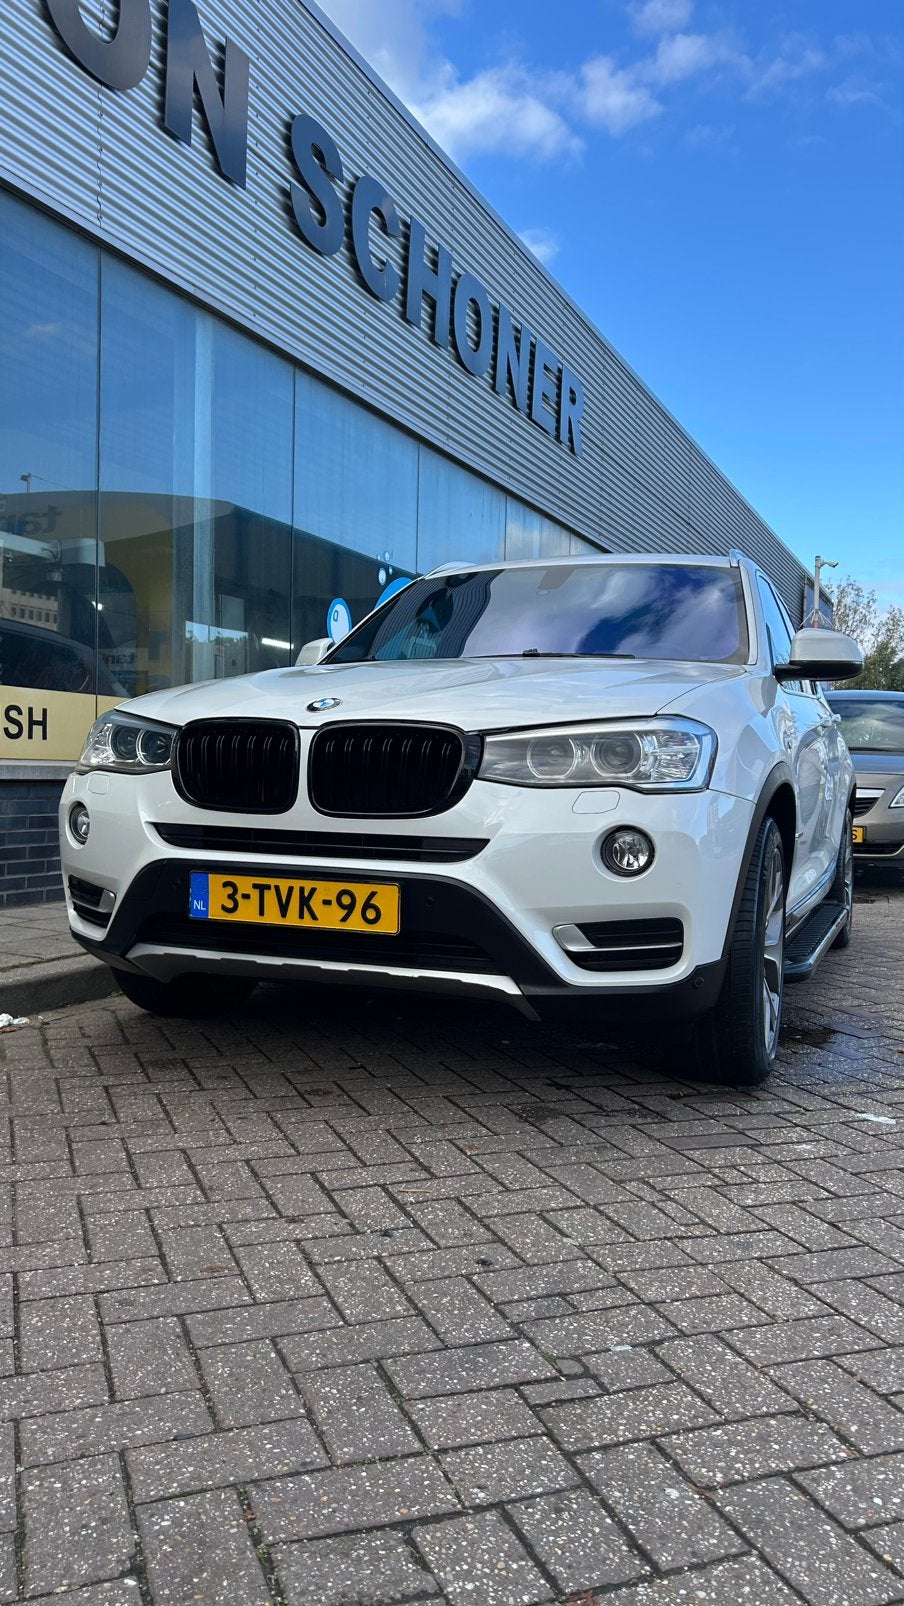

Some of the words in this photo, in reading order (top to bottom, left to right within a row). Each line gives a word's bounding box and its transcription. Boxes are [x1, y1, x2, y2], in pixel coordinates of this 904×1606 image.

[288, 113, 585, 458] SCHONER
[3, 704, 48, 741] SH
[193, 899, 206, 911] NL
[220, 880, 382, 925] 3-TVK-96
